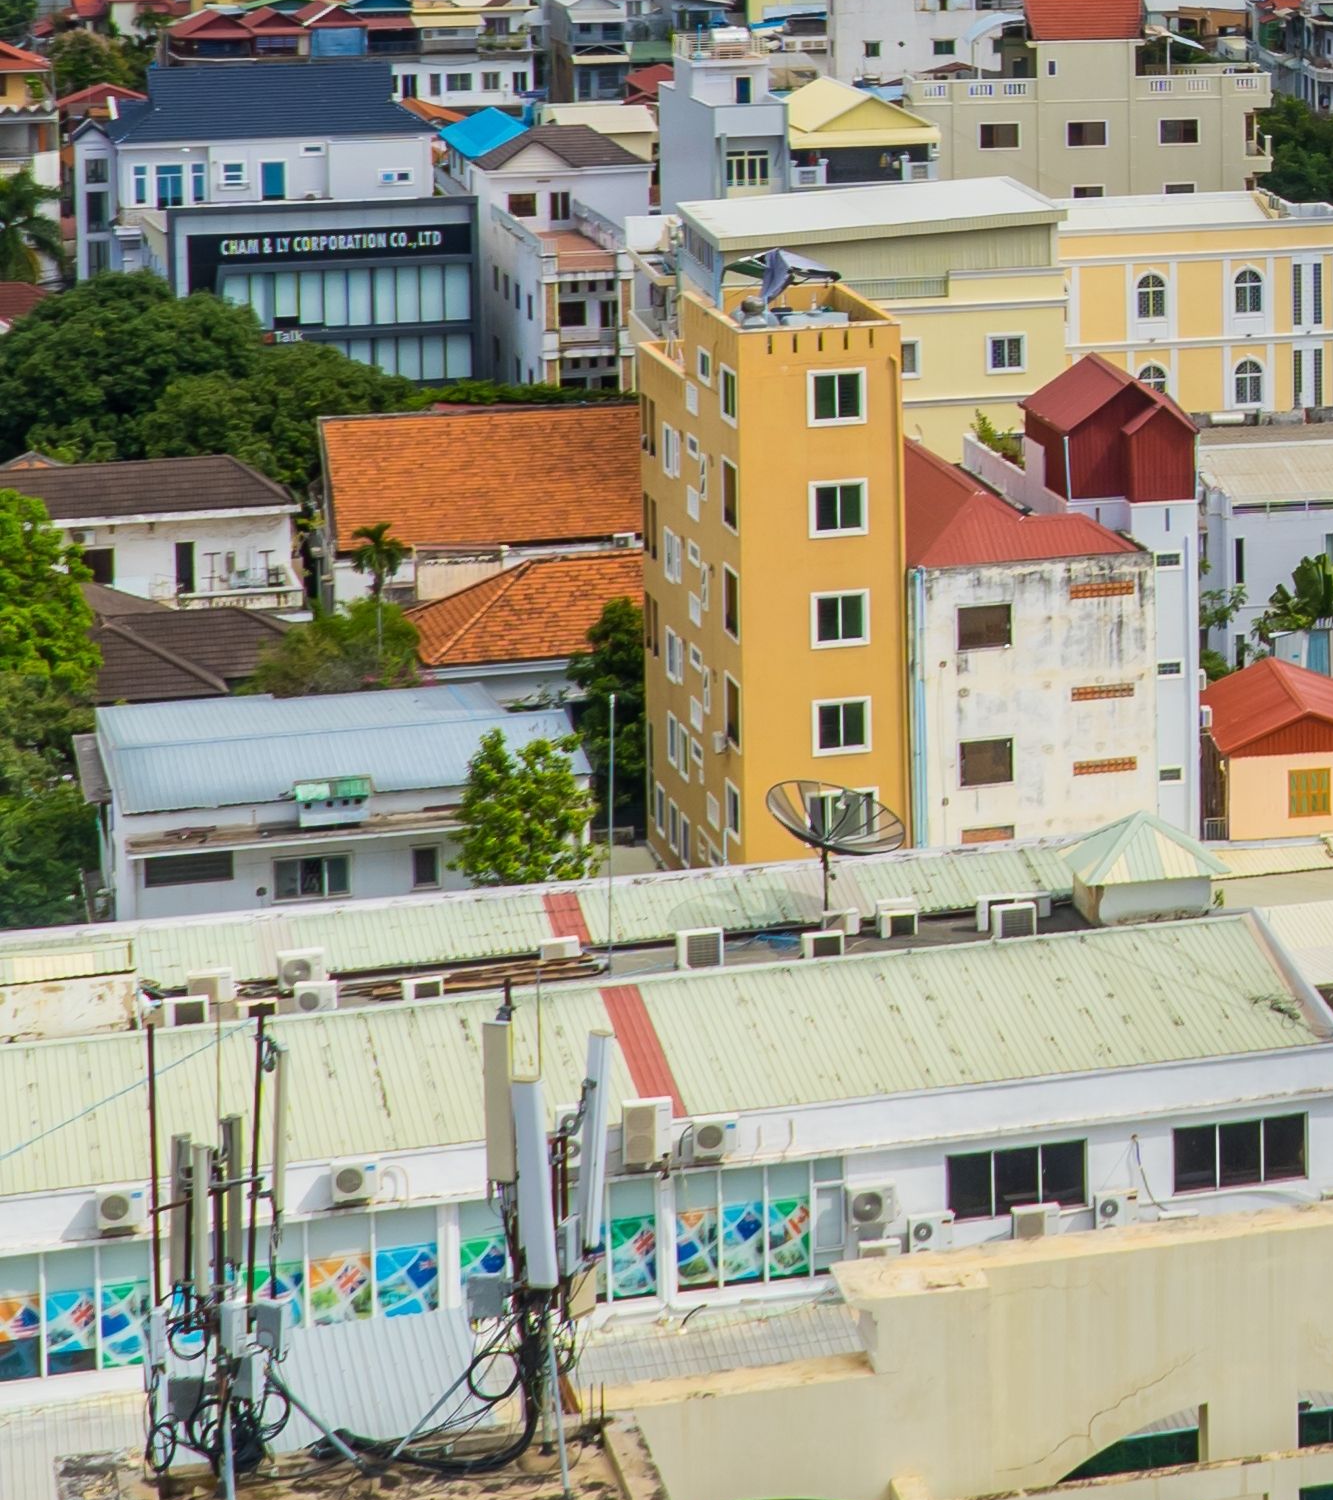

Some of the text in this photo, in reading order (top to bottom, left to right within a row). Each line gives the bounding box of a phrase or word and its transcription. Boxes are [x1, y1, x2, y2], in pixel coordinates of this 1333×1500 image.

[220, 239, 259, 256] CHAM
[262, 237, 273, 254] &
[276, 237, 291, 253] LY
[293, 232, 386, 252] CORPORATION
